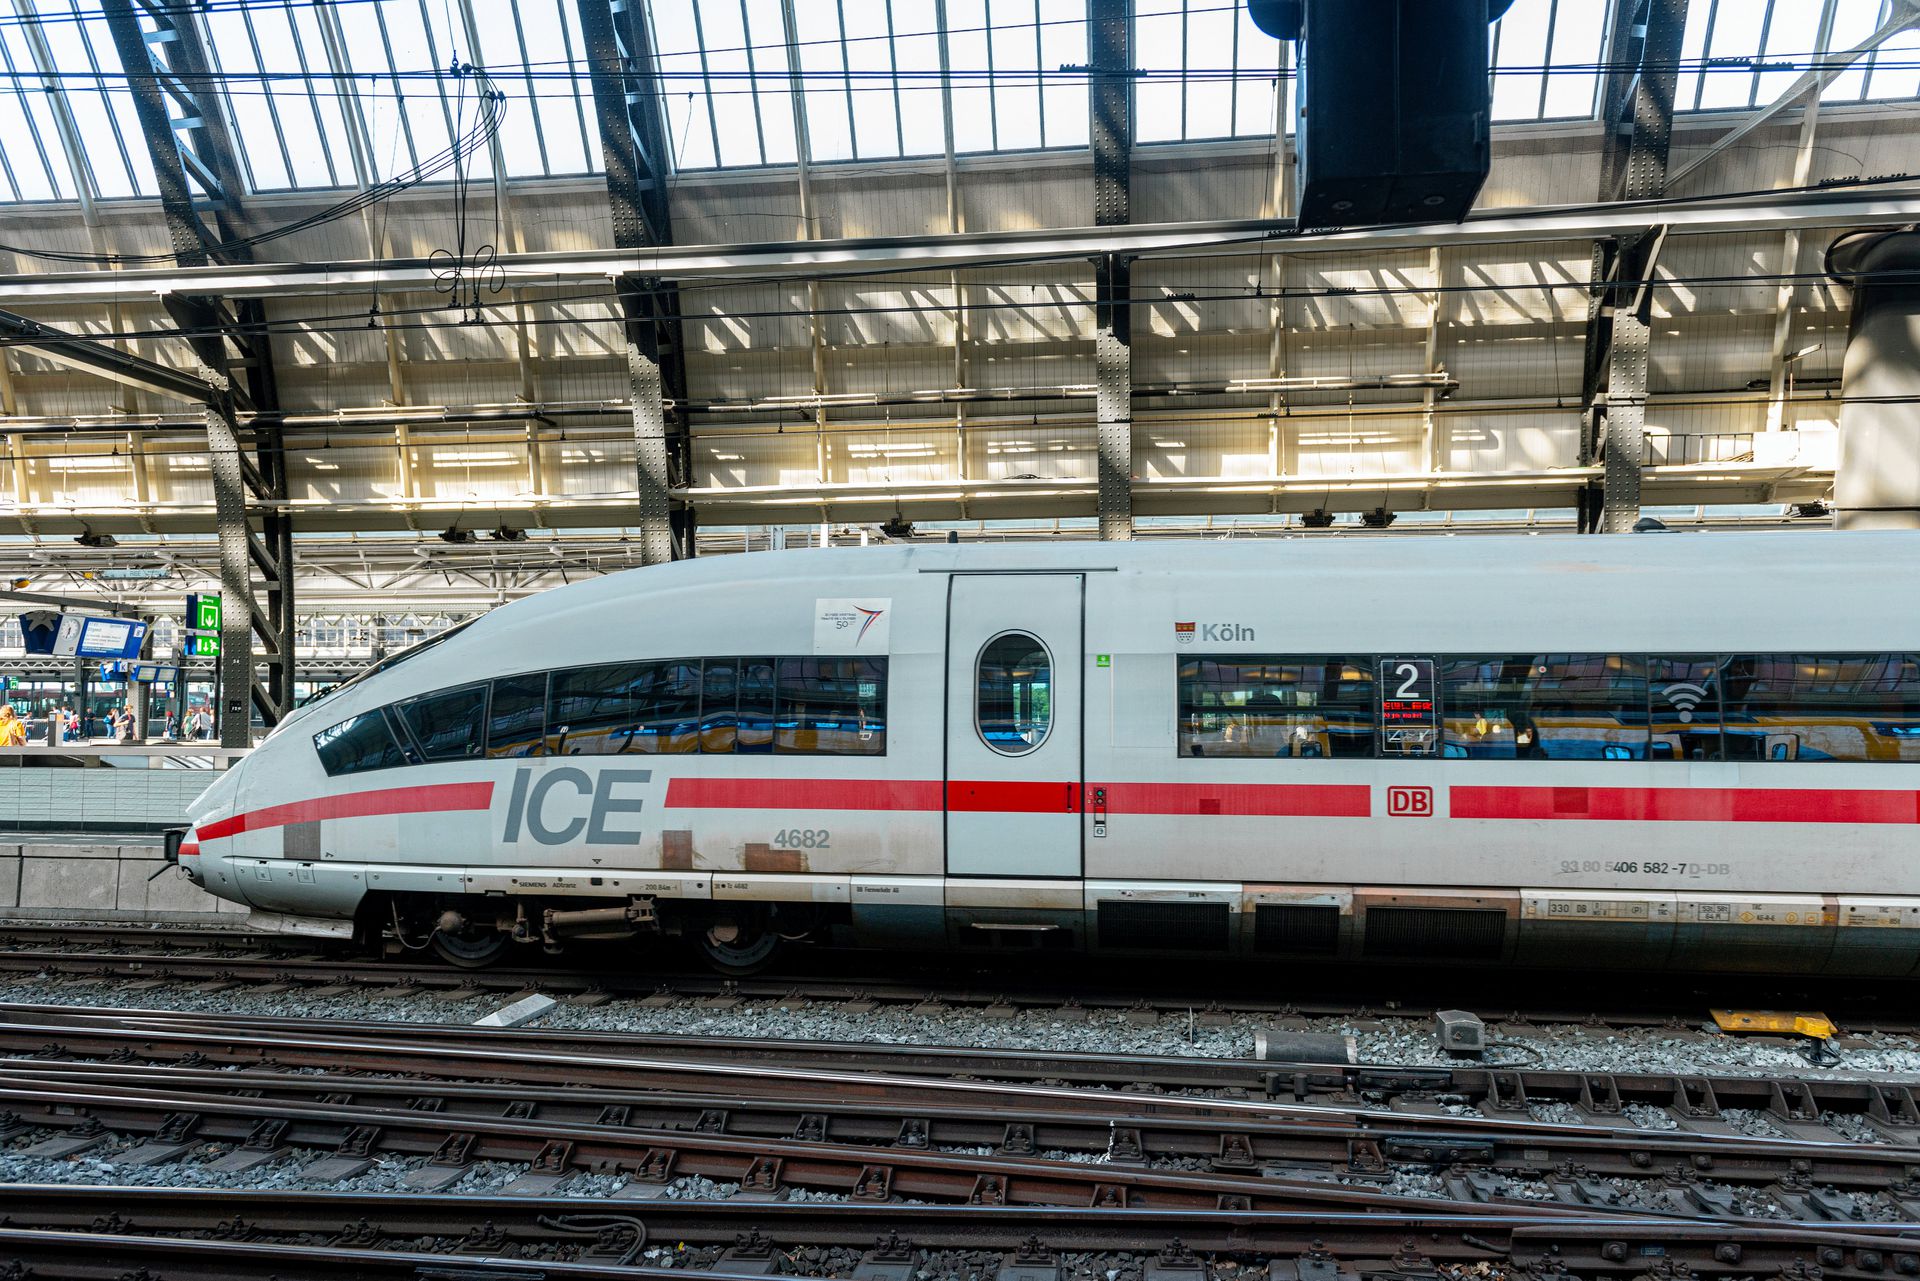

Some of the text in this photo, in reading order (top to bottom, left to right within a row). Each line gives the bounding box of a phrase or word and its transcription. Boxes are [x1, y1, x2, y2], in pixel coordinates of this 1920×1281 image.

[836, 621, 848, 630] 50
[1202, 623, 1255, 642] Köln
[1395, 664, 1420, 698] 2
[503, 767, 652, 845] ICE
[1392, 790, 1428, 812] DB
[774, 830, 830, 849] 4682
[1582, 860, 1600, 872] 80
[1551, 904, 1570, 913] 330
